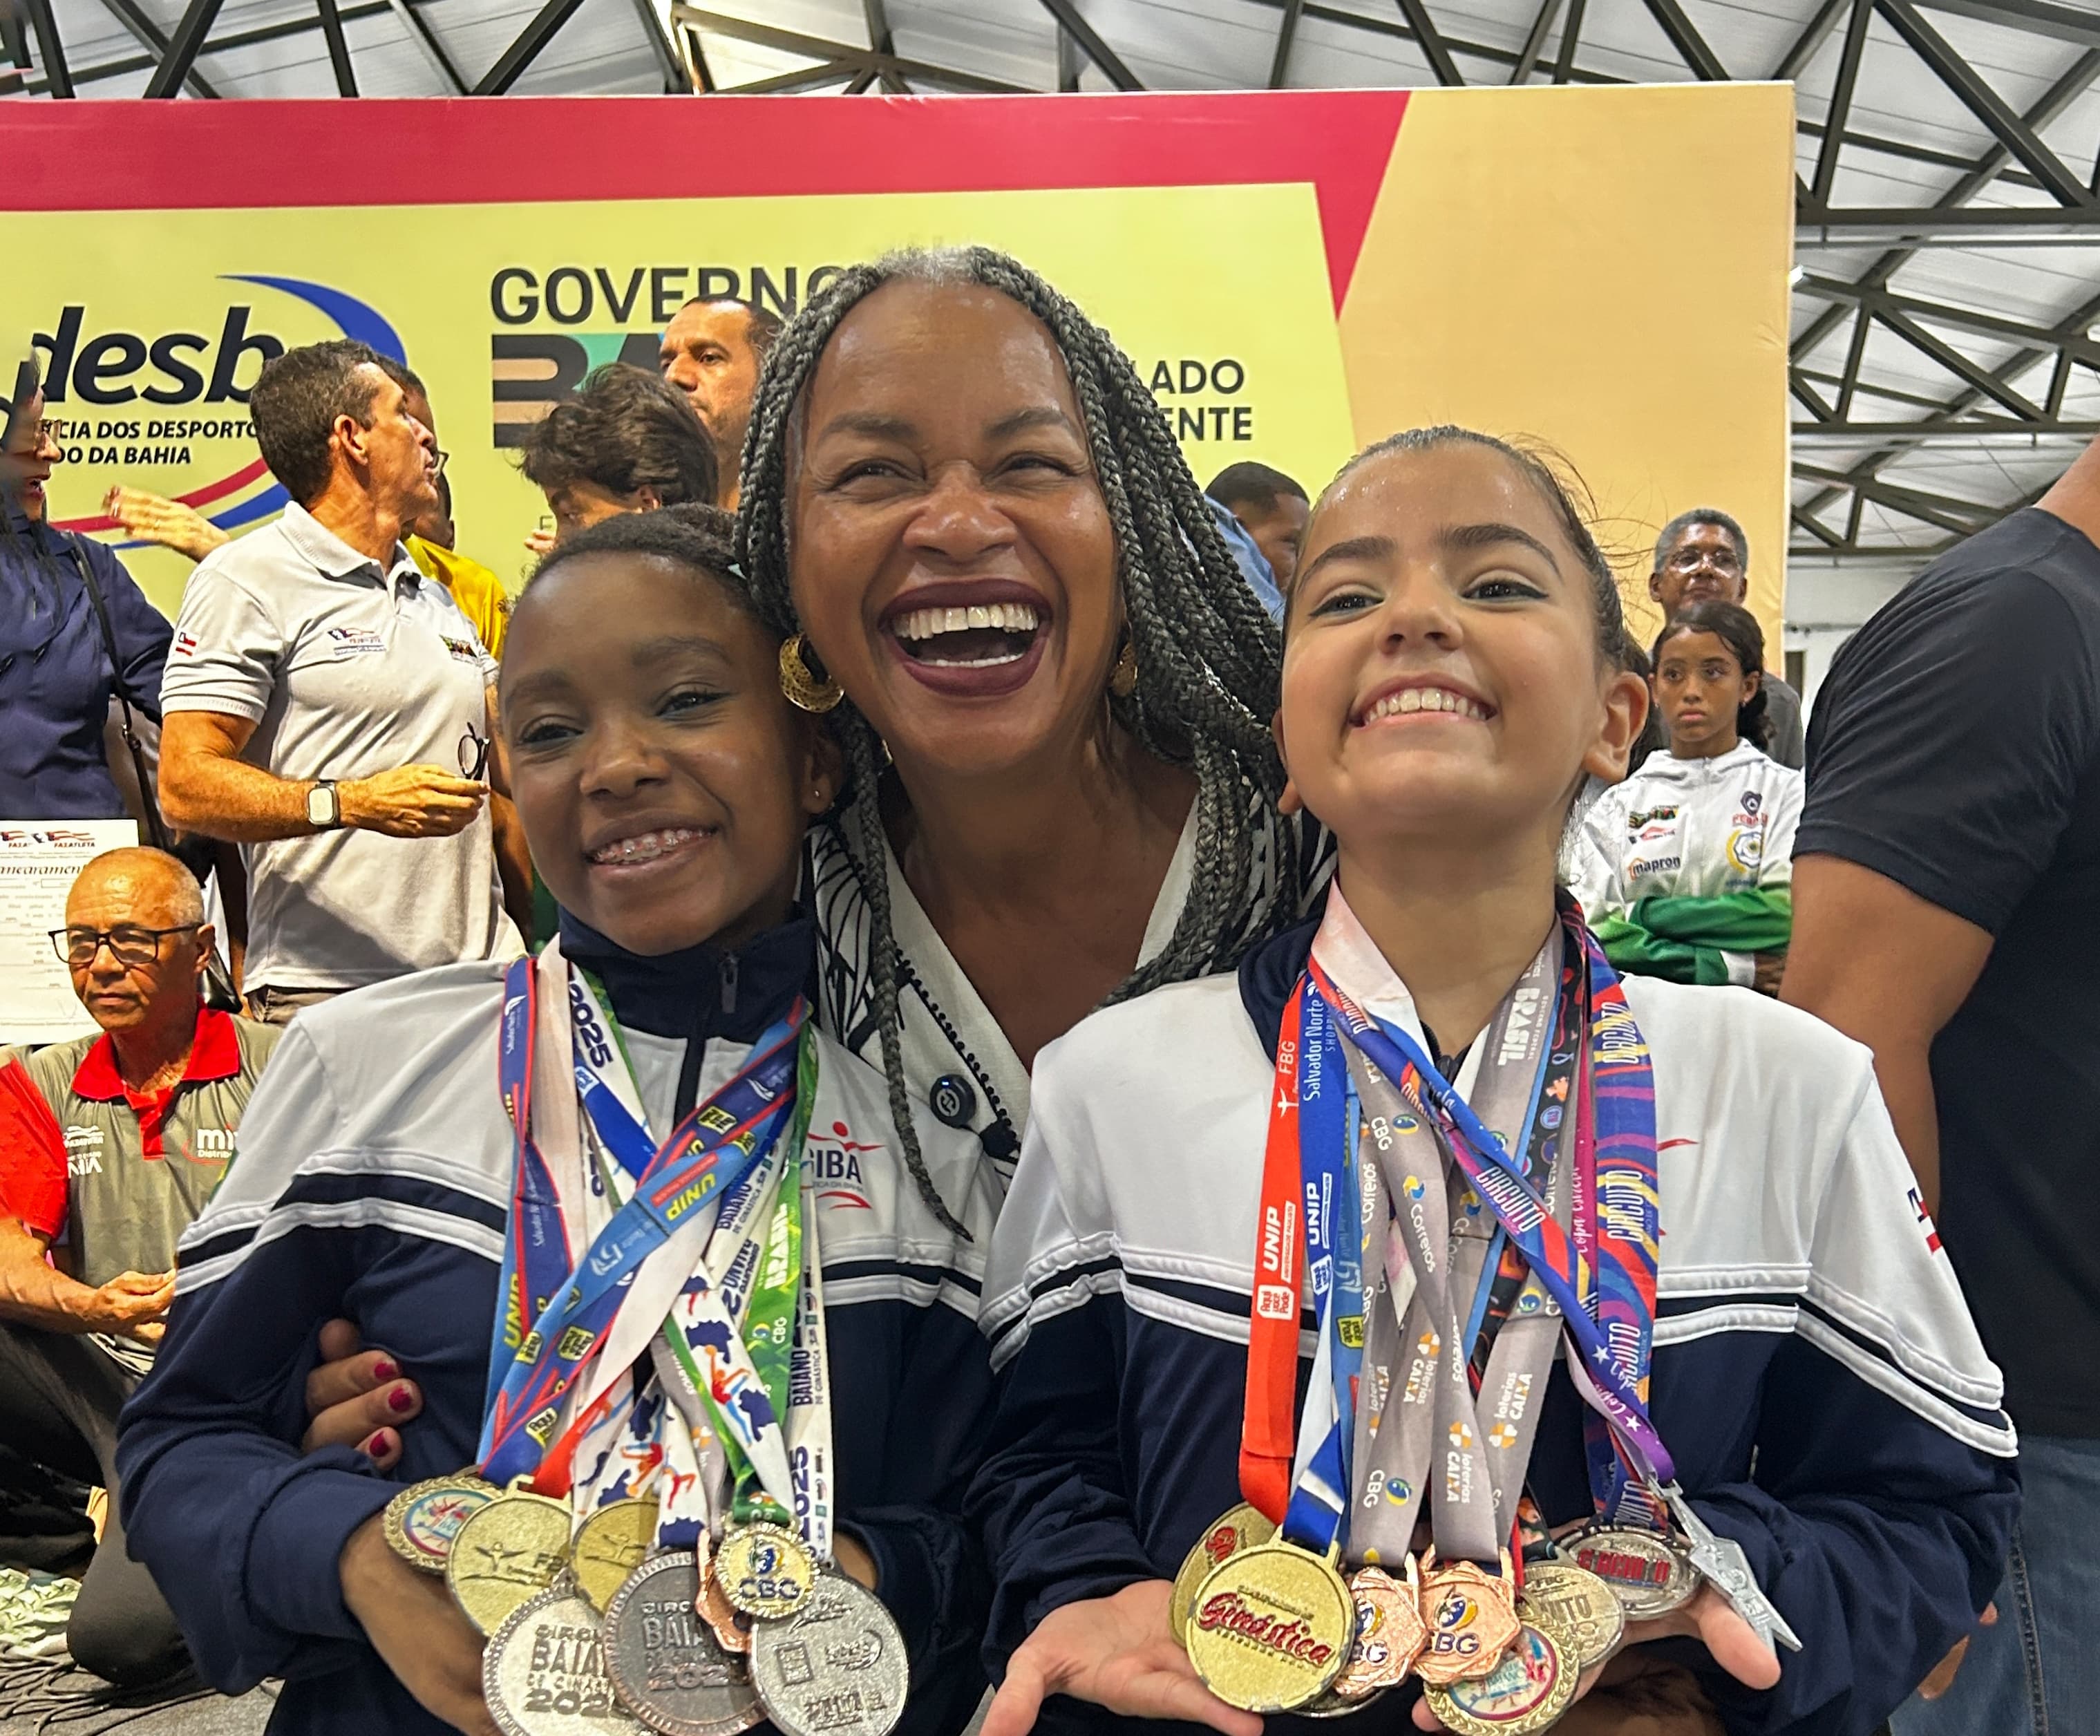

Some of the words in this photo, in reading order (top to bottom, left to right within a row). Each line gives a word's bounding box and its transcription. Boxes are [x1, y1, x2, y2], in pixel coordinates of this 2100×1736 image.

[1135, 359, 1245, 395] ADO
[97, 420, 140, 439] DOS
[1165, 406, 1252, 442] NTE
[88, 446, 119, 464] DA
[124, 446, 191, 464] BAHIA
[1633, 855, 1681, 875] mapron
[569, 982, 614, 1068] 2025
[1305, 998, 1324, 1037] Norte
[1497, 988, 1541, 1066] BRASIL
[1601, 1002, 1640, 1064] CIRCUITO
[1278, 1041, 1296, 1075] FBG
[1303, 1037, 1322, 1102] Salvador
[1371, 1116, 1393, 1151] CBG
[666, 1173, 717, 1221] UNIP
[717, 1180, 753, 1231] BAIANO
[1306, 1182, 1321, 1245] UNIP
[1361, 1163, 1377, 1224] Correios
[1476, 1166, 1546, 1234] CIRCUITO
[1605, 1169, 1645, 1243] CIRCUITO
[763, 1203, 790, 1290] BRASIL
[1263, 1206, 1281, 1272] UNIP
[1410, 1204, 1437, 1273] Correios
[1260, 1291, 1271, 1312] Aqui
[1279, 1292, 1291, 1319] Pode
[772, 1316, 788, 1344] CBG
[793, 1349, 814, 1406] BAIANO
[1403, 1359, 1425, 1404] CAIXA
[1417, 1359, 1438, 1405] loterias
[1494, 1372, 1517, 1419] loterias
[1509, 1373, 1533, 1420] CAIXA
[1363, 1469, 1385, 1508] CBG
[1446, 1451, 1461, 1502] CAIXA
[1461, 1452, 1473, 1504] loterias
[534, 1553, 569, 1573] FB
[641, 1601, 690, 1614] CIRC
[739, 1577, 800, 1601] CBG
[1199, 1592, 1333, 1667] Ginástica
[1434, 1632, 1479, 1655] BG
[530, 1638, 604, 1677] BAIA
[648, 1662, 730, 1691] 202
